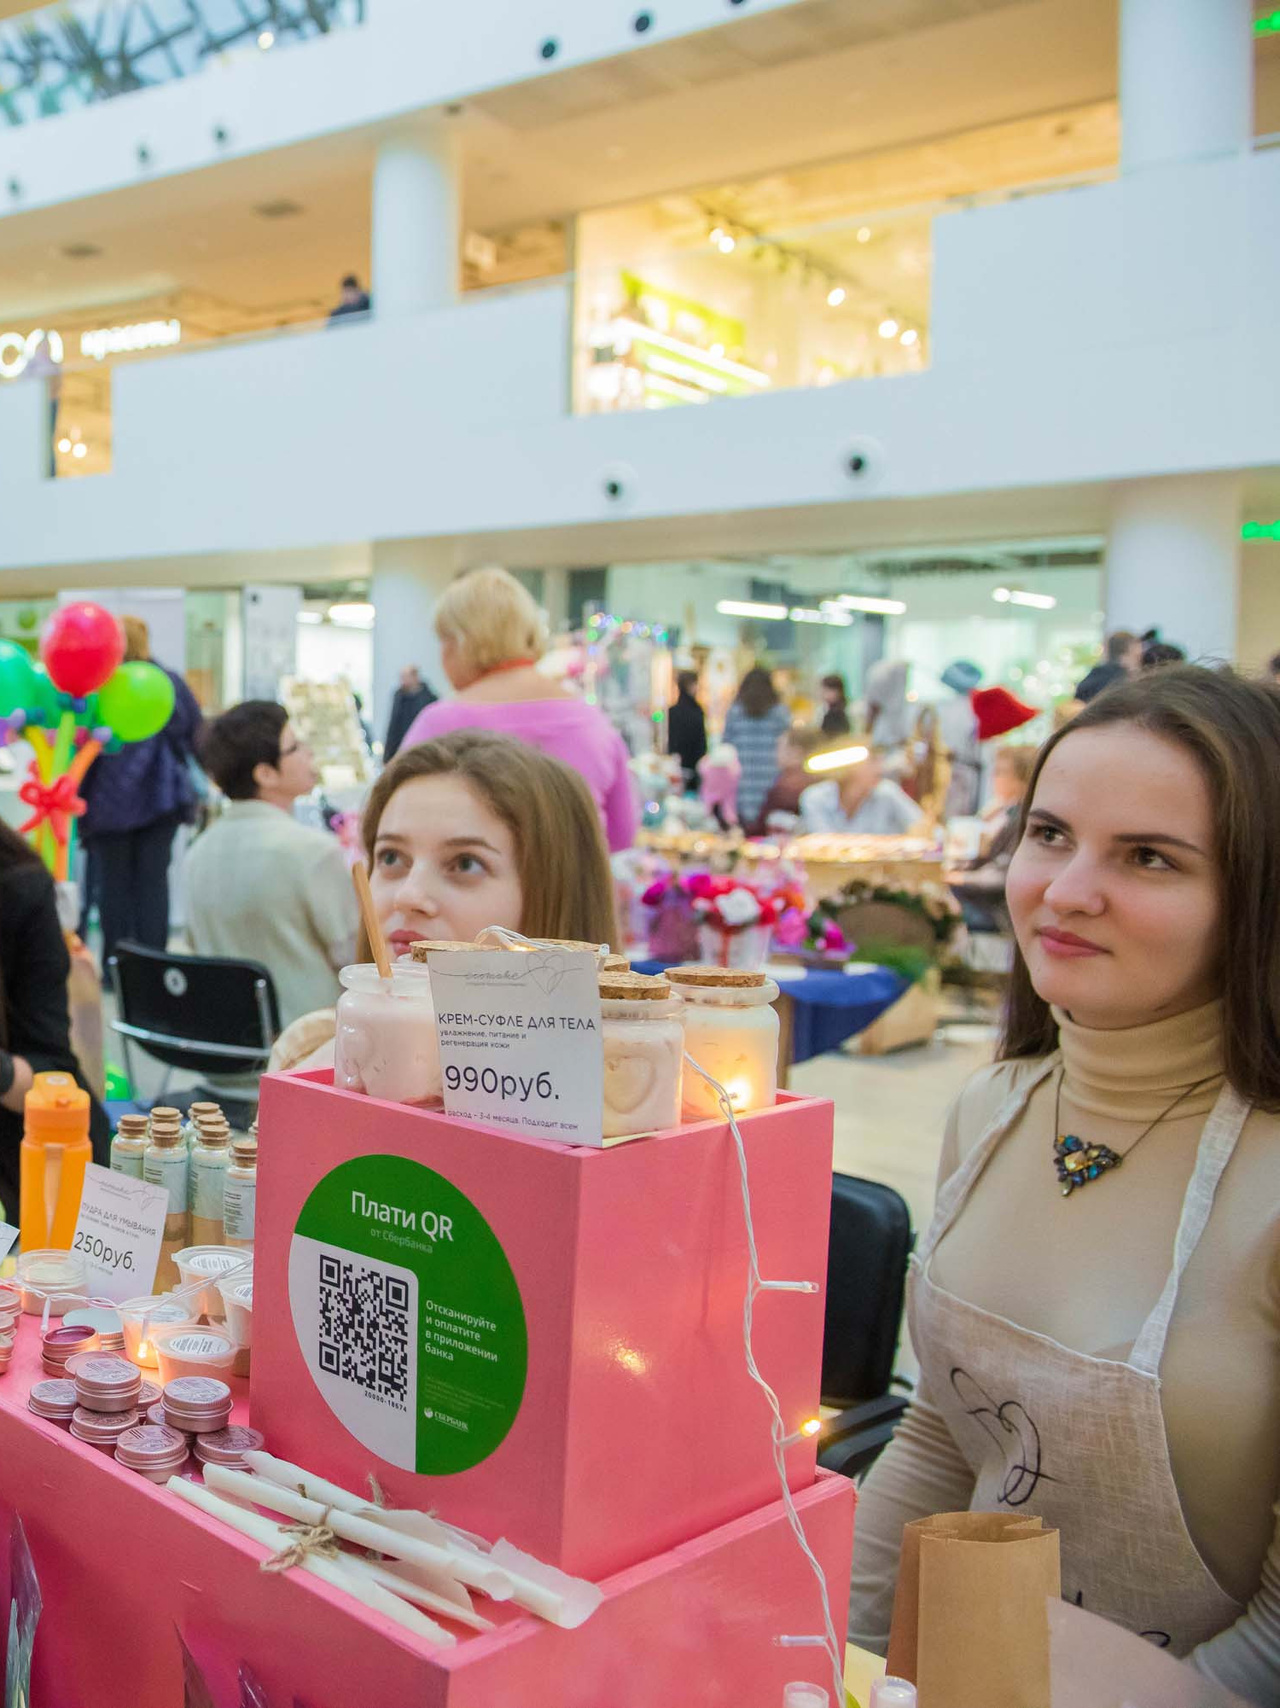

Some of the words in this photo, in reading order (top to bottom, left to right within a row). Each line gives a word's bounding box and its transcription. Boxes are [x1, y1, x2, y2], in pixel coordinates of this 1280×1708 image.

[438, 1013, 524, 1028] КРЕМ-СУФЛЕ
[527, 1016, 556, 1030] ДЛЯ
[560, 1017, 596, 1031] ТЕЛА
[445, 1065, 560, 1102] 990руб.
[351, 1190, 416, 1231] Плати
[421, 1211, 454, 1242] QR
[74, 1231, 135, 1273] 250руб.
[370, 1228, 382, 1237] от
[382, 1230, 434, 1254] Сбербанка
[426, 1300, 497, 1332] Отсканируйте
[426, 1316, 432, 1325] и
[434, 1319, 481, 1342] оплатите
[424, 1343, 454, 1361] банка
[425, 1330, 431, 1339] в
[433, 1331, 498, 1362] приложении
